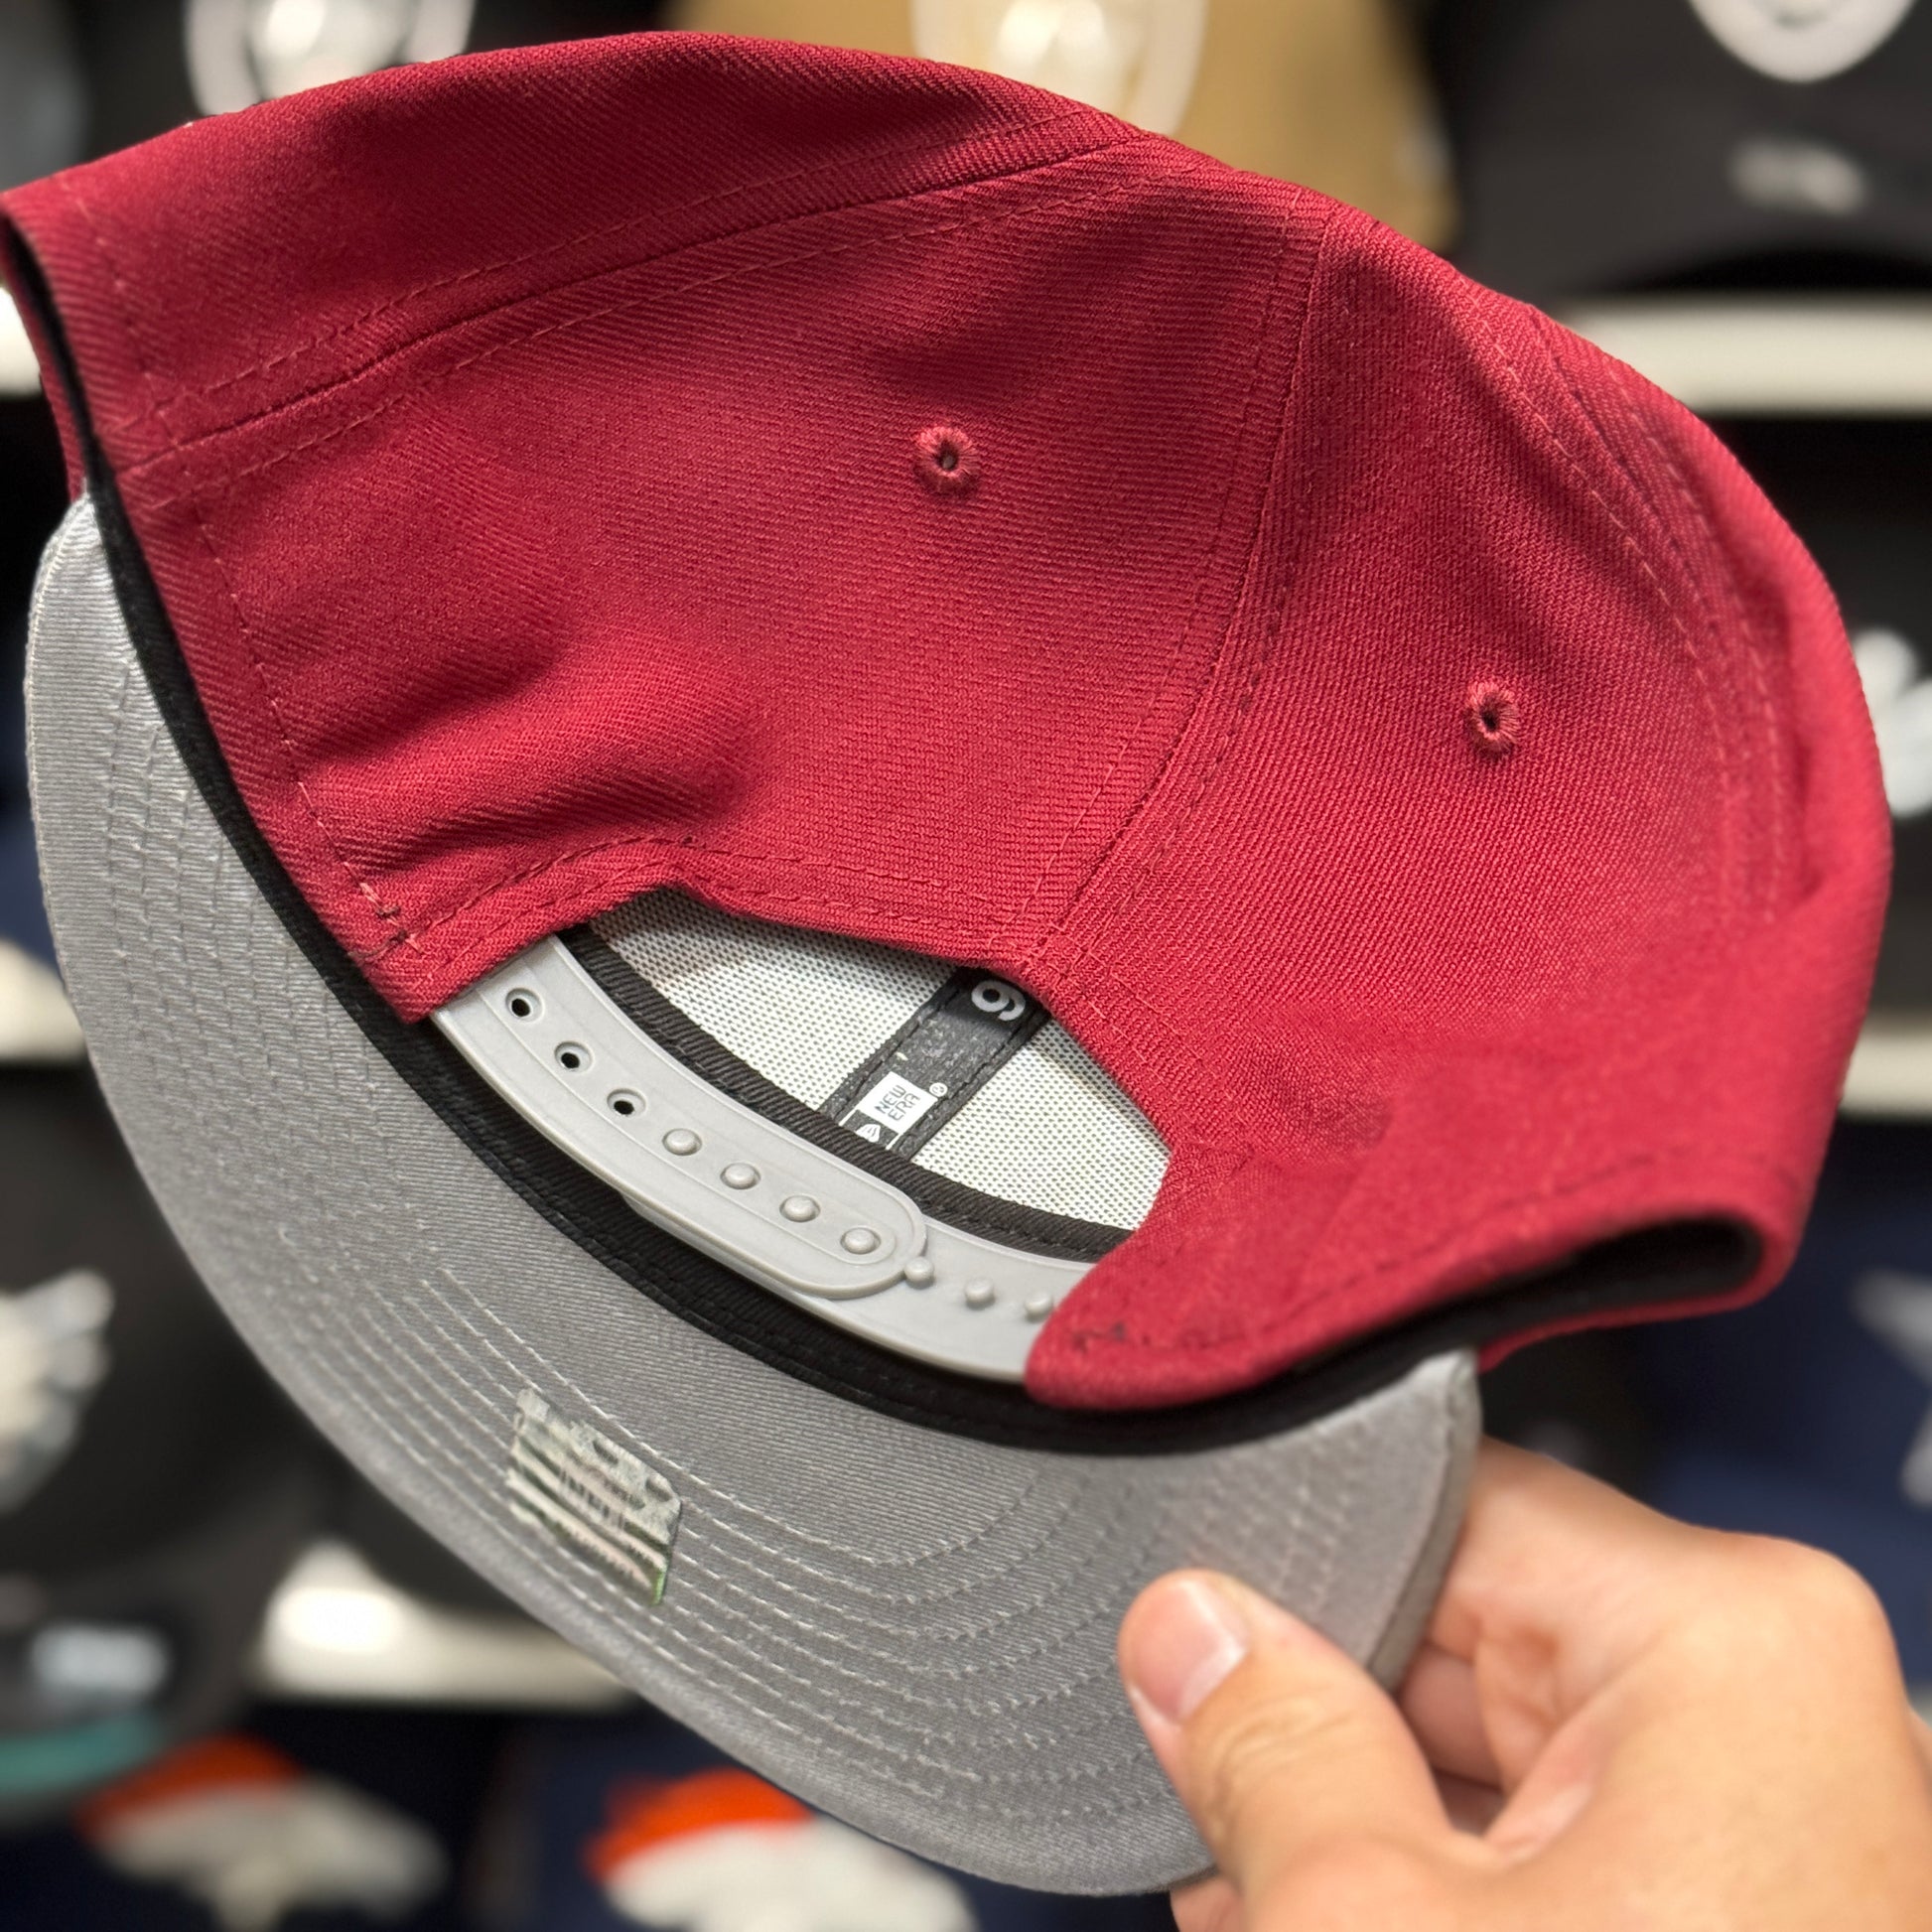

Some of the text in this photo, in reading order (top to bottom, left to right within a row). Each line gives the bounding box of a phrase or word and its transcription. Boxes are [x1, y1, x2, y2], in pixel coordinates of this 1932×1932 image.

[971, 980, 1027, 1022] 9
[874, 1084, 906, 1114] NEW
[888, 1093, 921, 1121] ERA
